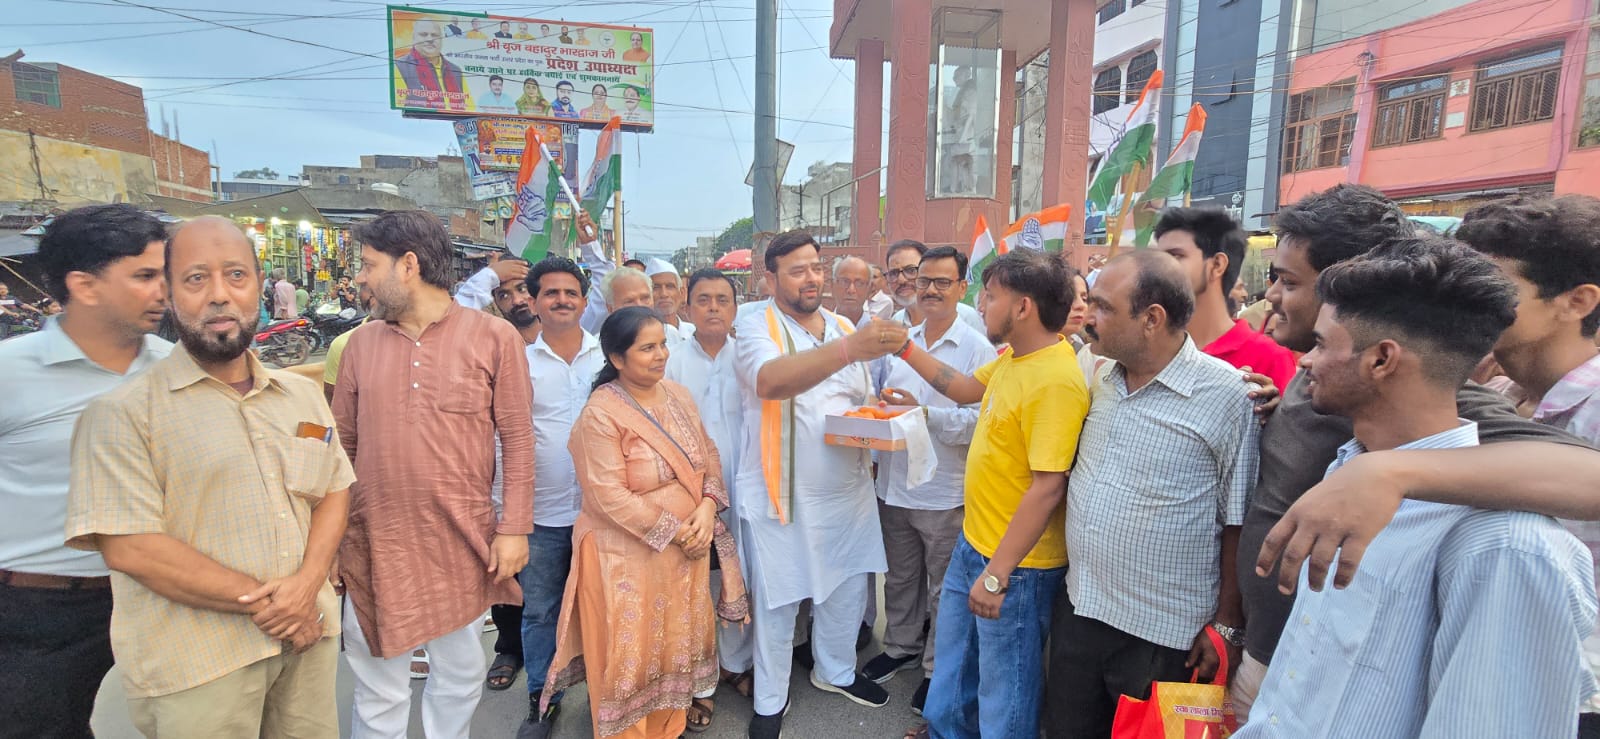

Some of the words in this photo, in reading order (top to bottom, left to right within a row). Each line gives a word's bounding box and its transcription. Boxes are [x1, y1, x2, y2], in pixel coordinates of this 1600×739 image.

[486, 38, 500, 50] श्री
[601, 48, 615, 60] जी
[546, 56, 579, 71] प्रदेश
